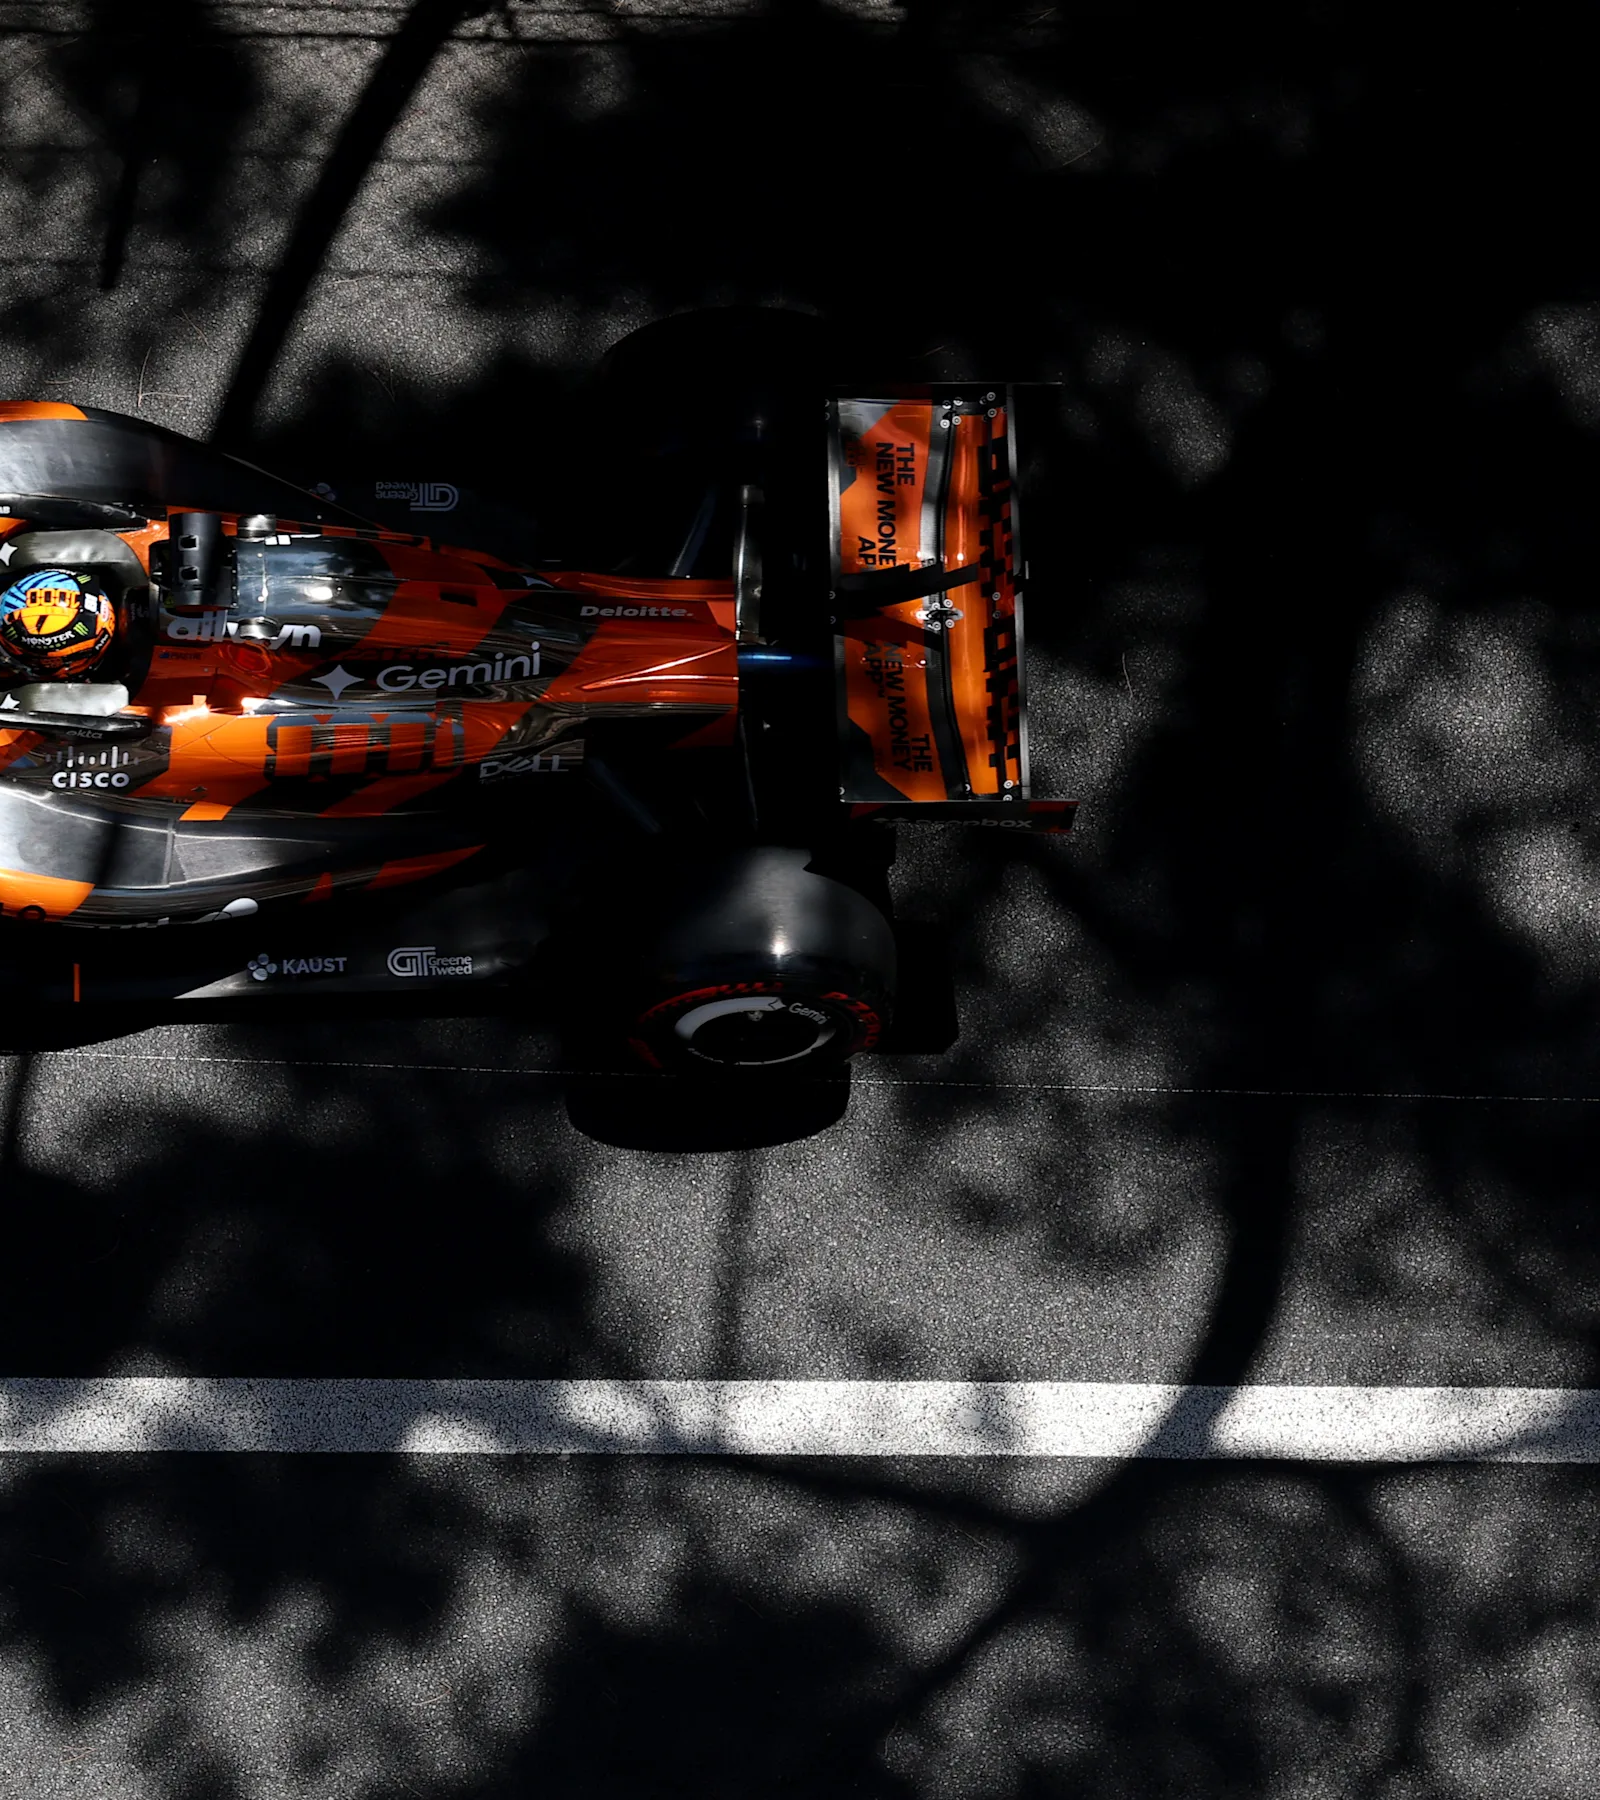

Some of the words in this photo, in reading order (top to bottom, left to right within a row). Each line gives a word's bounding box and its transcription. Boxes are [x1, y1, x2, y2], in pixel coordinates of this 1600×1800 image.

[875, 442, 895, 495] NEW
[897, 442, 915, 486] THE
[374, 490, 418, 500] Greene
[375, 481, 418, 492] Tweed
[877, 500, 897, 566] MONE
[858, 536, 876, 566] AP
[579, 605, 695, 617] Deloitte.
[21, 630, 75, 646] MONSTER
[376, 641, 541, 692] Gemini
[884, 640, 905, 692] NEW
[66, 729, 104, 740] okta
[887, 696, 913, 772] MONEY
[911, 734, 933, 772] THE
[479, 754, 569, 779] DELL
[51, 771, 131, 788] CISCO
[283, 956, 348, 975] KAUST
[429, 955, 473, 967] Greene
[429, 965, 473, 976] Tweed
[788, 1002, 831, 1025] Gemini
